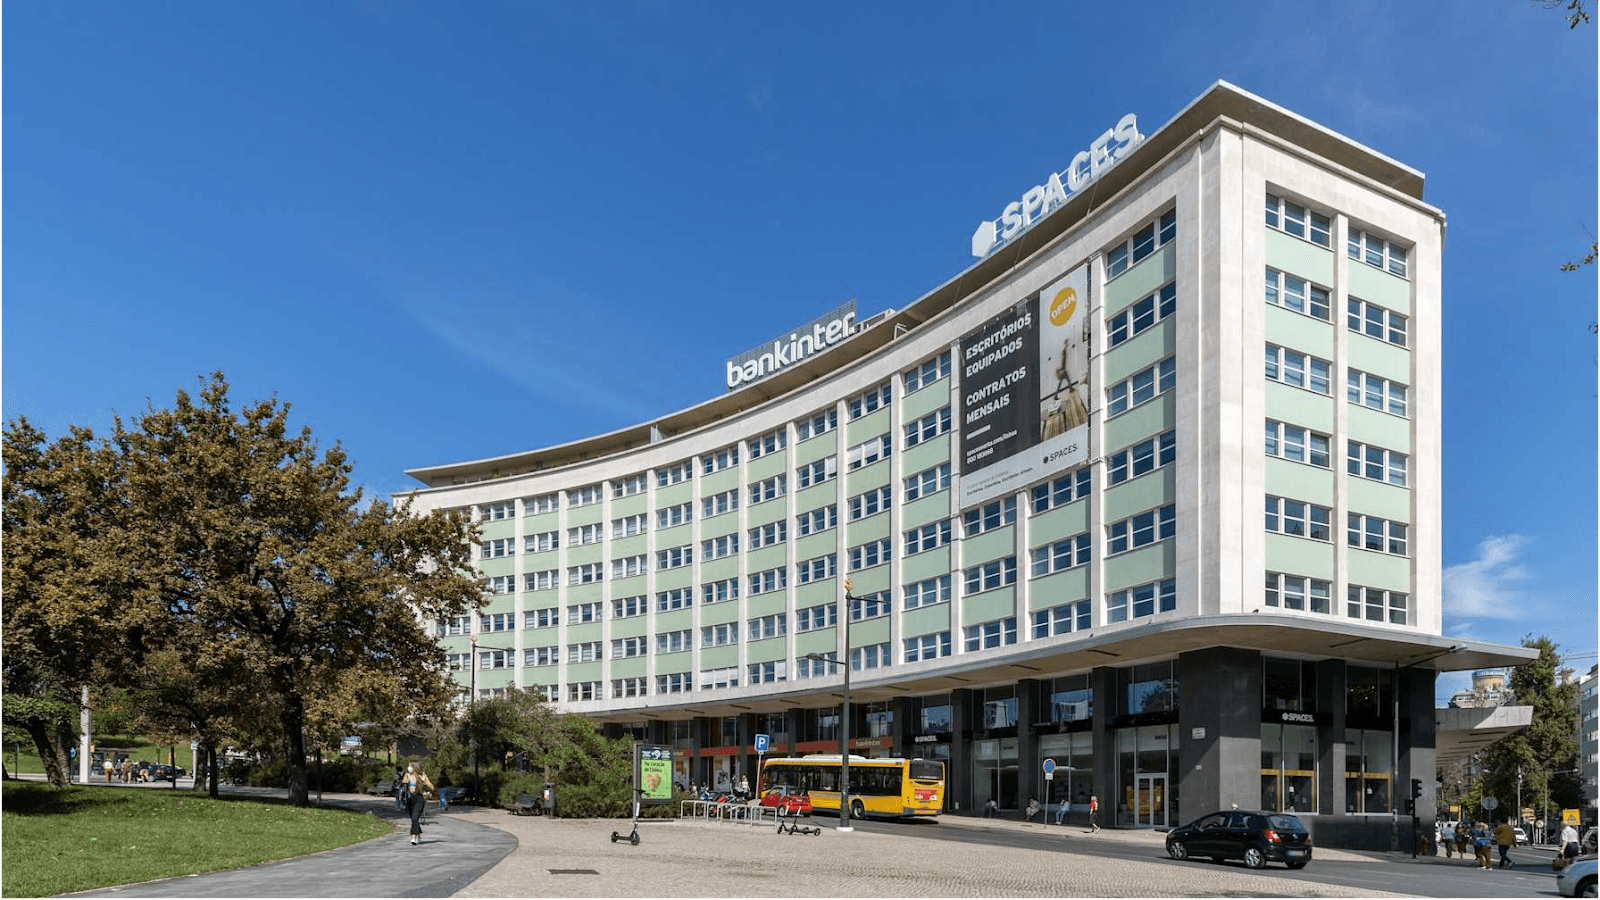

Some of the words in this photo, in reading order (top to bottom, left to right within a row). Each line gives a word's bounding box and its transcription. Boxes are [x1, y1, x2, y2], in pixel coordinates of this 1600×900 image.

[1051, 292, 1076, 319] OPEN
[965, 312, 1032, 360] ESCRITÓRIOS
[965, 337, 1024, 378] EQUIPADOS
[965, 365, 1027, 406] CONTRATOS
[966, 393, 1011, 425] MENSAIS
[758, 737, 766, 748] P
